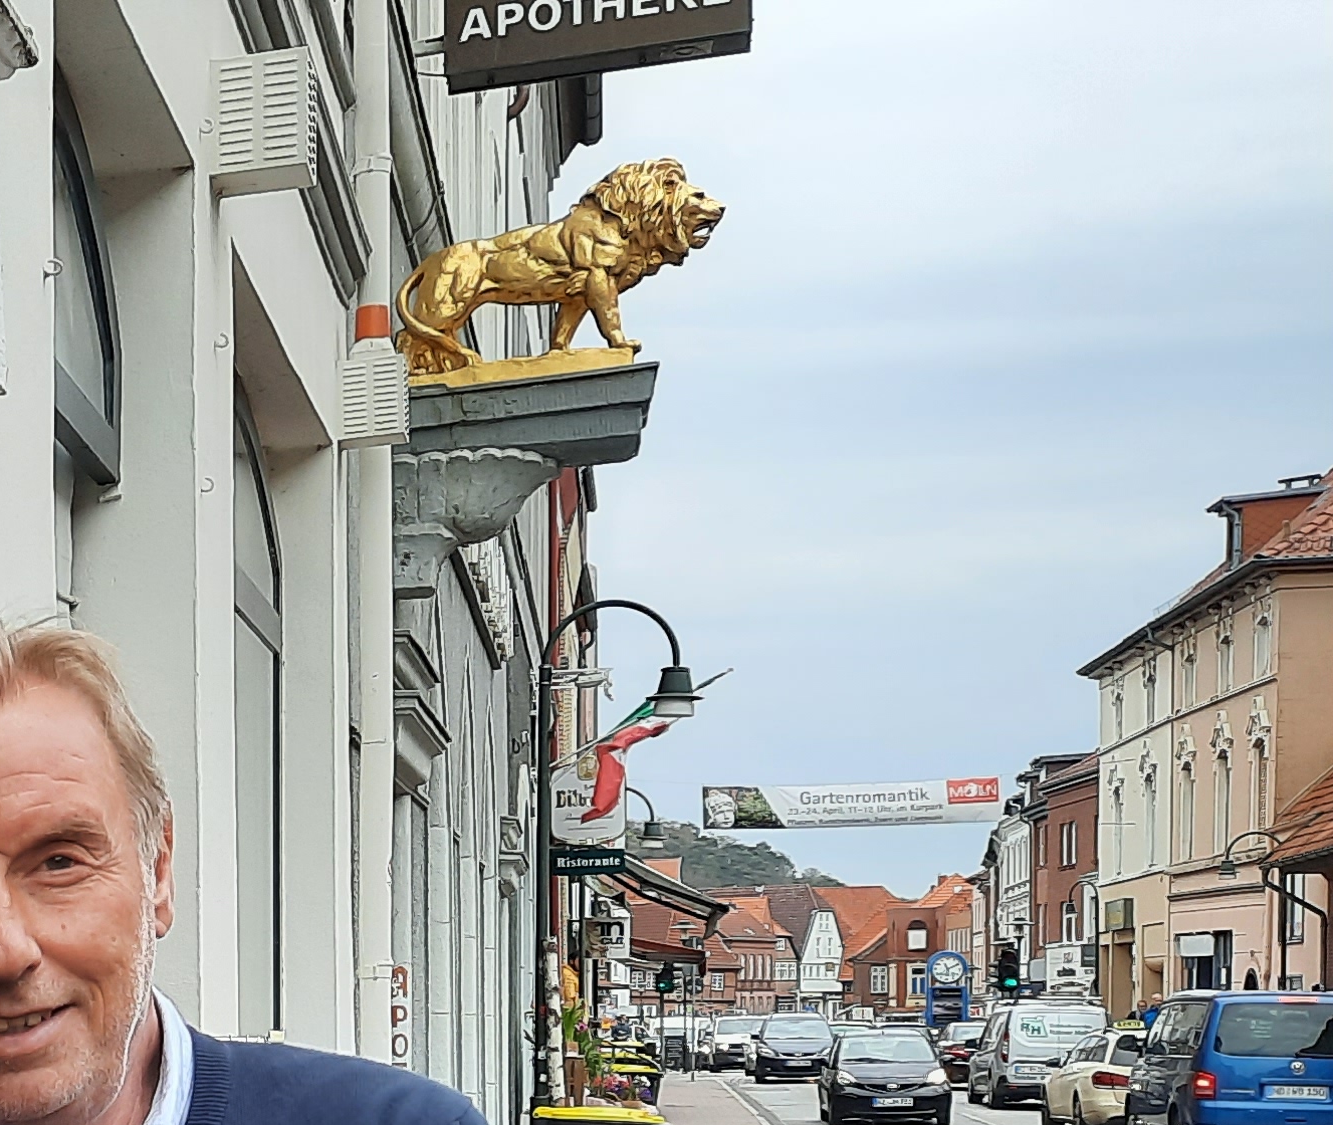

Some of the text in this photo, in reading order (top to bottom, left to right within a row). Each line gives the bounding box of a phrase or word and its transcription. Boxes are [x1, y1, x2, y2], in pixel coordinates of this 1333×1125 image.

[459, 0, 731, 42] APOTHE
[800, 788, 930, 805] Gartenromantik
[391, 966, 408, 1068] APO
